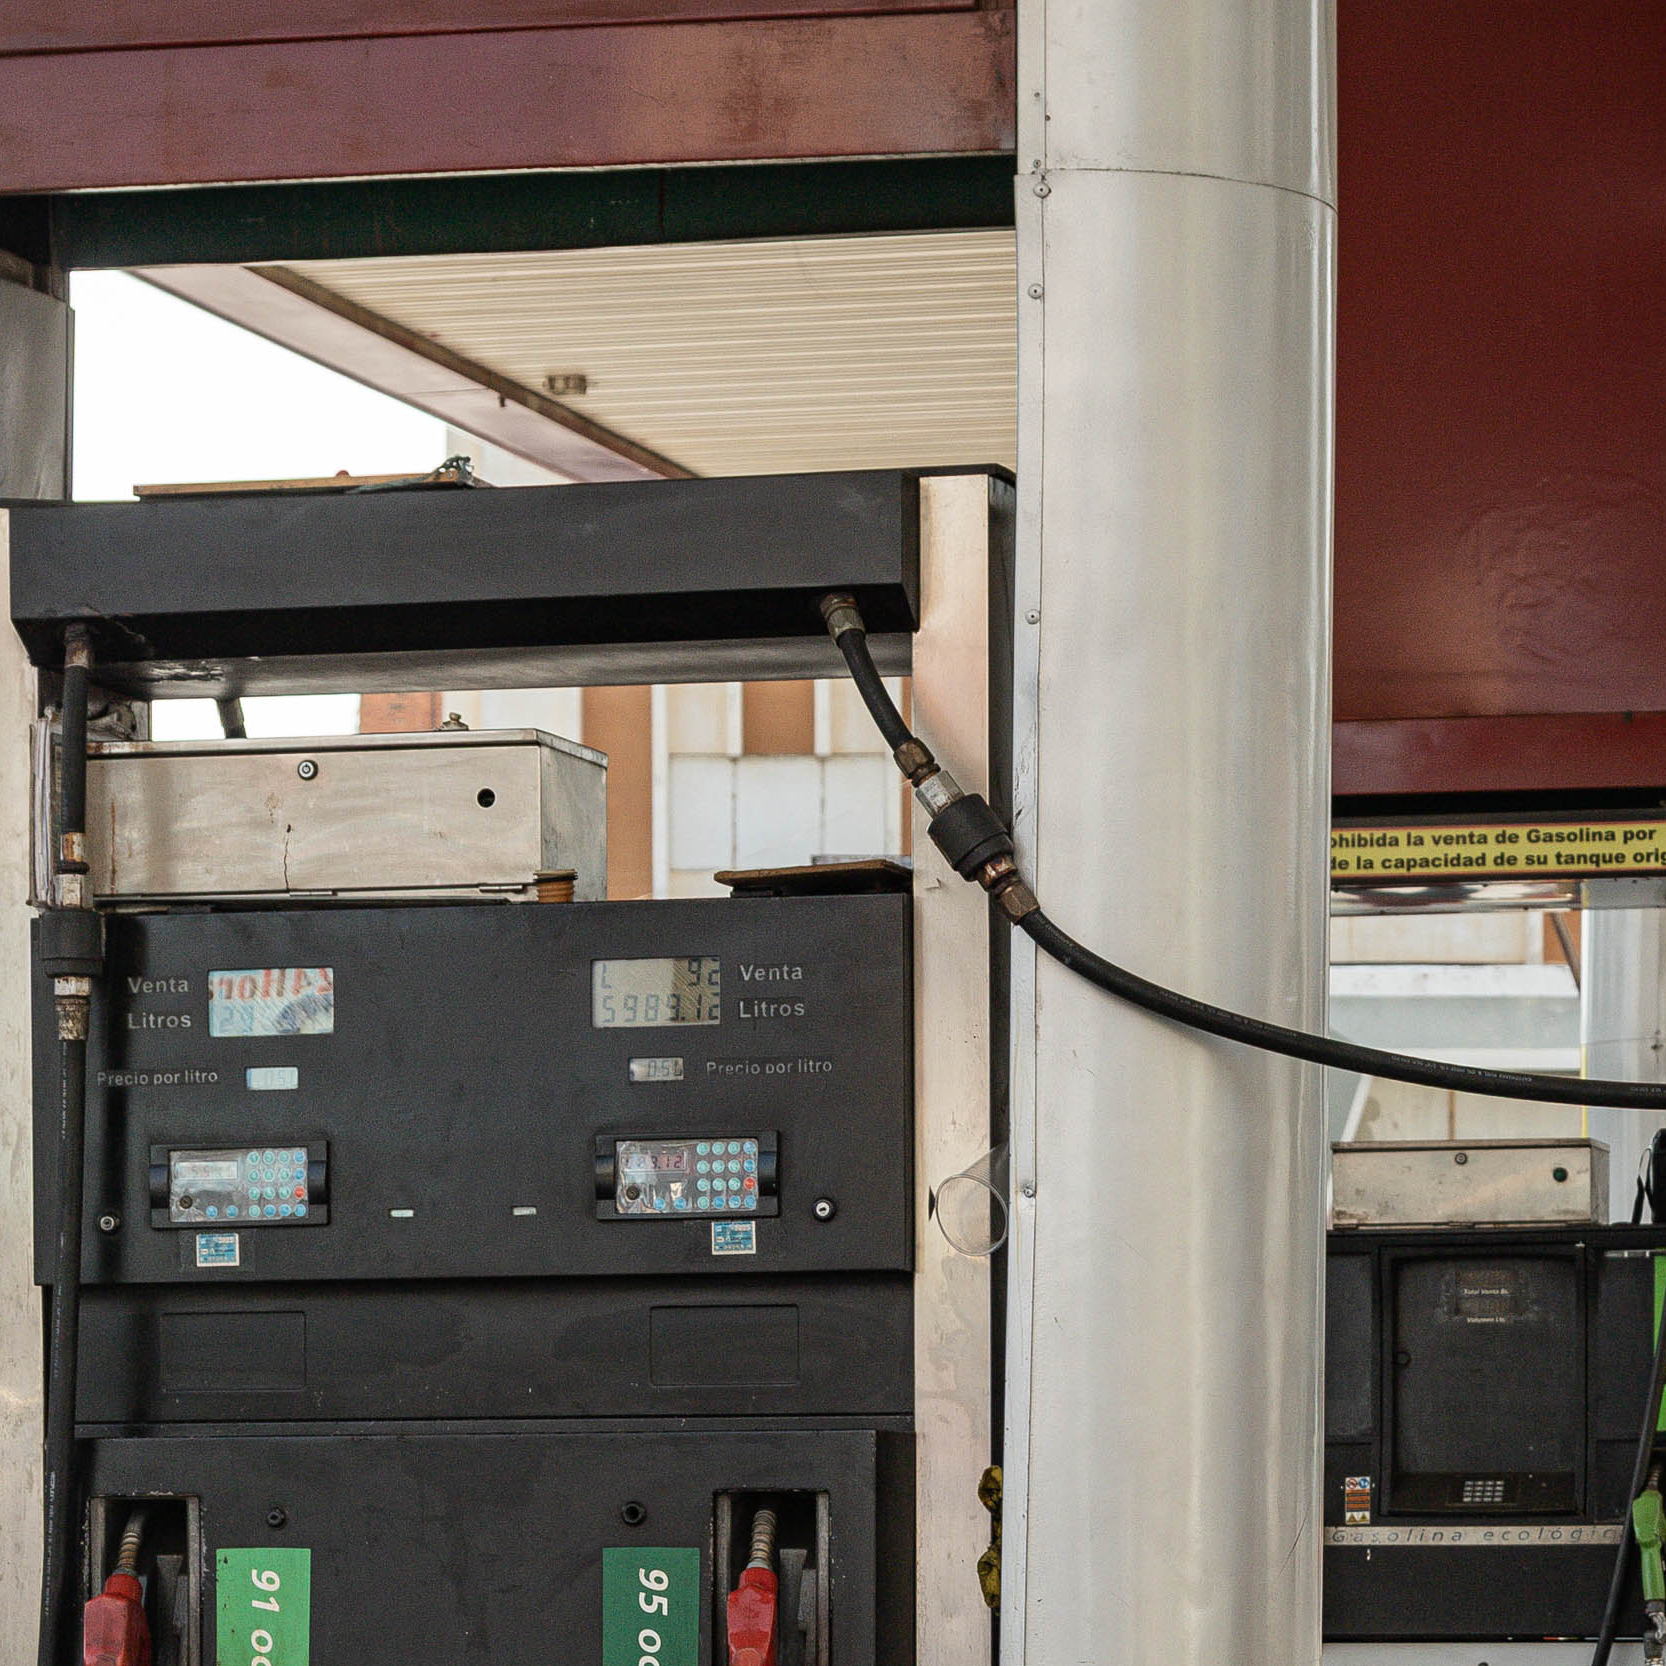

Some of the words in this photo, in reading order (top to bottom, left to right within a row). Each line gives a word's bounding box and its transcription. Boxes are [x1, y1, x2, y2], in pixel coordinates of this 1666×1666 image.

[1406, 831, 1426, 847] la
[1431, 831, 1489, 846] venta
[1494, 829, 1520, 845] de
[1526, 826, 1616, 844] Gasolina
[1622, 827, 1656, 845] por
[1356, 853, 1374, 870] la
[1380, 851, 1487, 872] capacidad
[1493, 850, 1518, 867] de
[1524, 852, 1549, 867] su
[1555, 850, 1625, 870] tanque
[739, 964, 803, 982] Venta
[127, 976, 189, 994] Venta
[739, 999, 805, 1018] Litros
[127, 1011, 192, 1030] Litros
[706, 1060, 761, 1076] Precio
[765, 1061, 792, 1076] por
[797, 1058, 833, 1074] litro
[96, 1069, 149, 1087] Precio
[152, 1071, 180, 1088] por
[184, 1068, 219, 1084] litro
[1331, 1527, 1464, 1544] Gasolina
[250, 1567, 281, 1613] 91
[638, 1567, 670, 1614] 95
